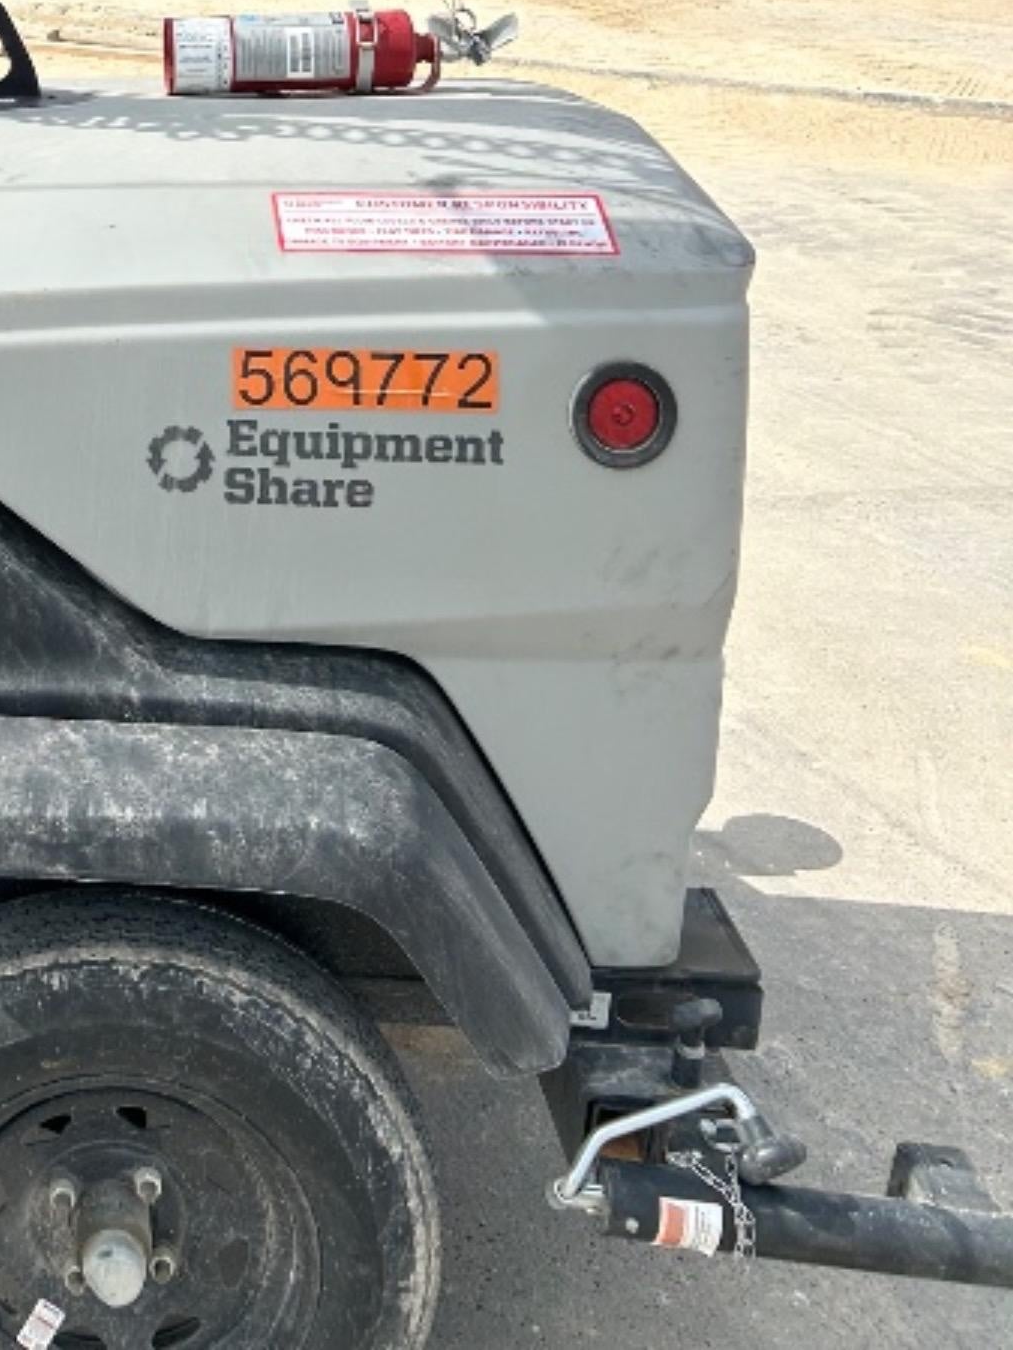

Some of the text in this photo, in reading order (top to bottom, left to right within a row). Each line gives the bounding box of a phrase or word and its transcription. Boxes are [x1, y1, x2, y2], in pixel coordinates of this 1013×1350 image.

[239, 350, 492, 408] 569772
[226, 419, 504, 468] Equipment
[224, 467, 374, 508] Share
